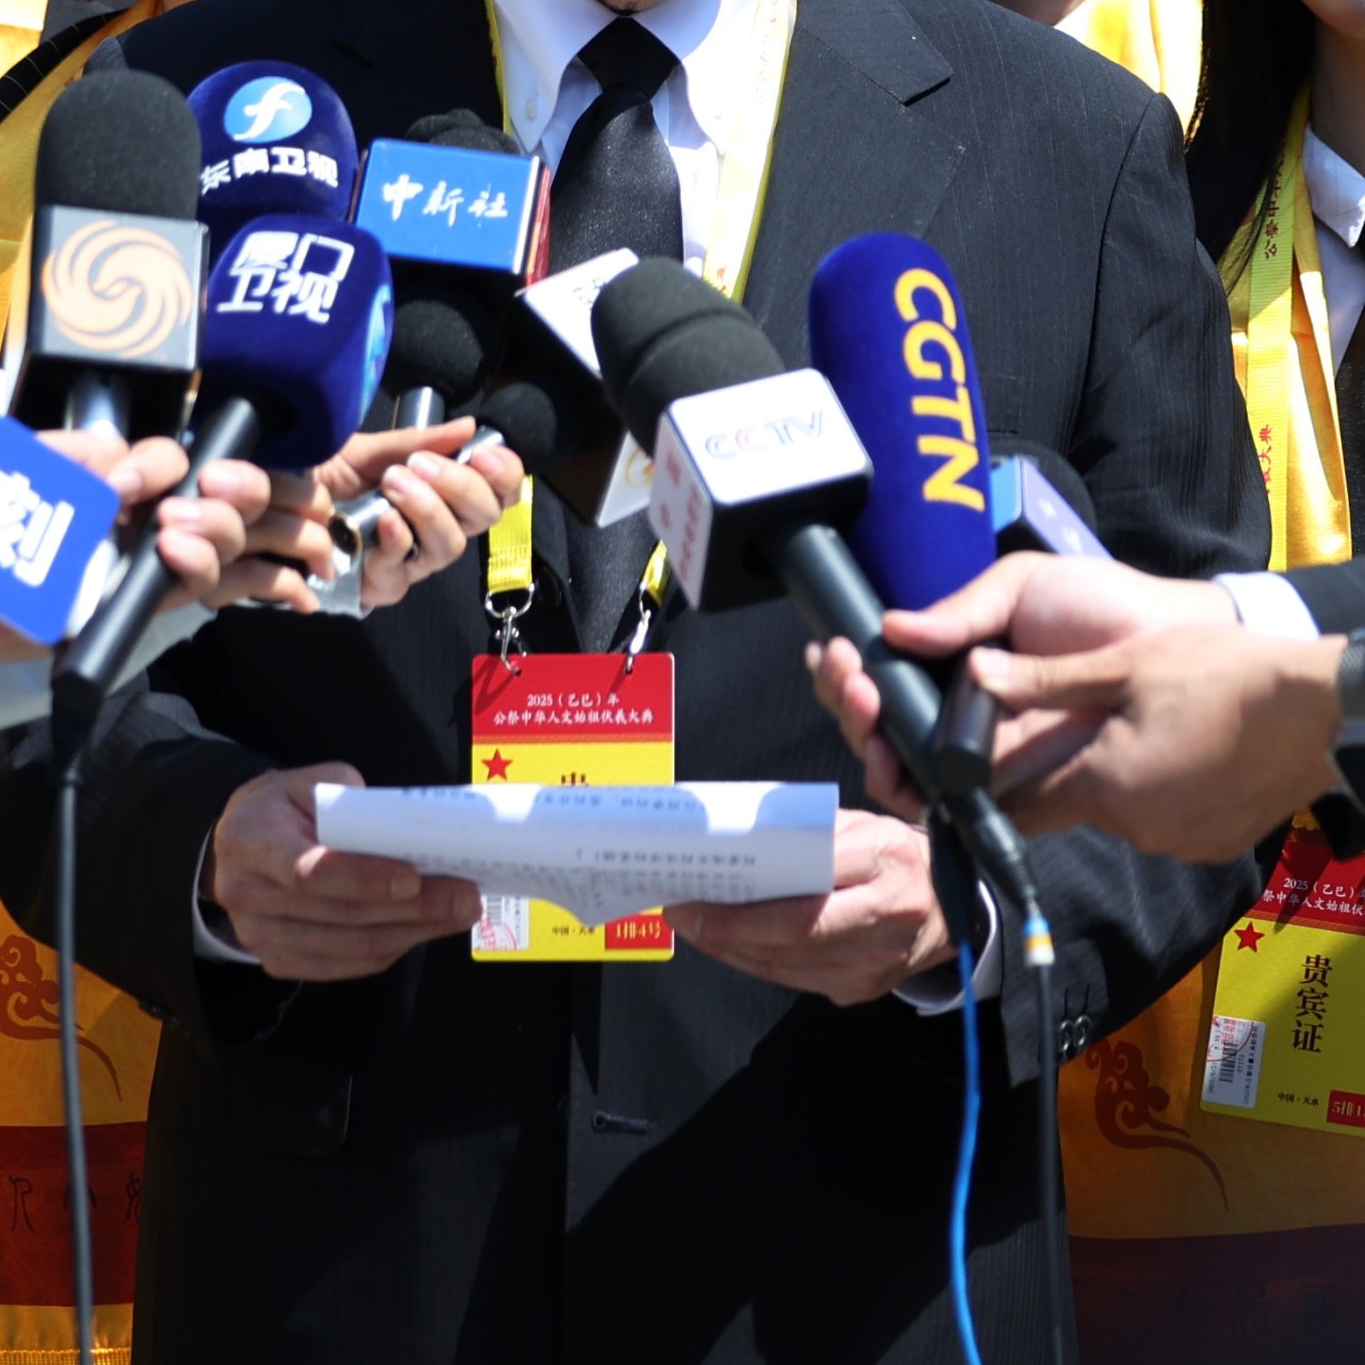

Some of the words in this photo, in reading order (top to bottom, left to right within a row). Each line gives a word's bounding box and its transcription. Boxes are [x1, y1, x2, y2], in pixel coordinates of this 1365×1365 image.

[199, 147, 339, 196] 东南卫视
[382, 173, 508, 227] 中新社
[232, 230, 355, 281] 厦门
[216, 268, 341, 324] 卫视
[893, 267, 985, 513] CGTN
[704, 410, 823, 460] CCTV
[1291, 954, 1334, 1054] 贵宾证
